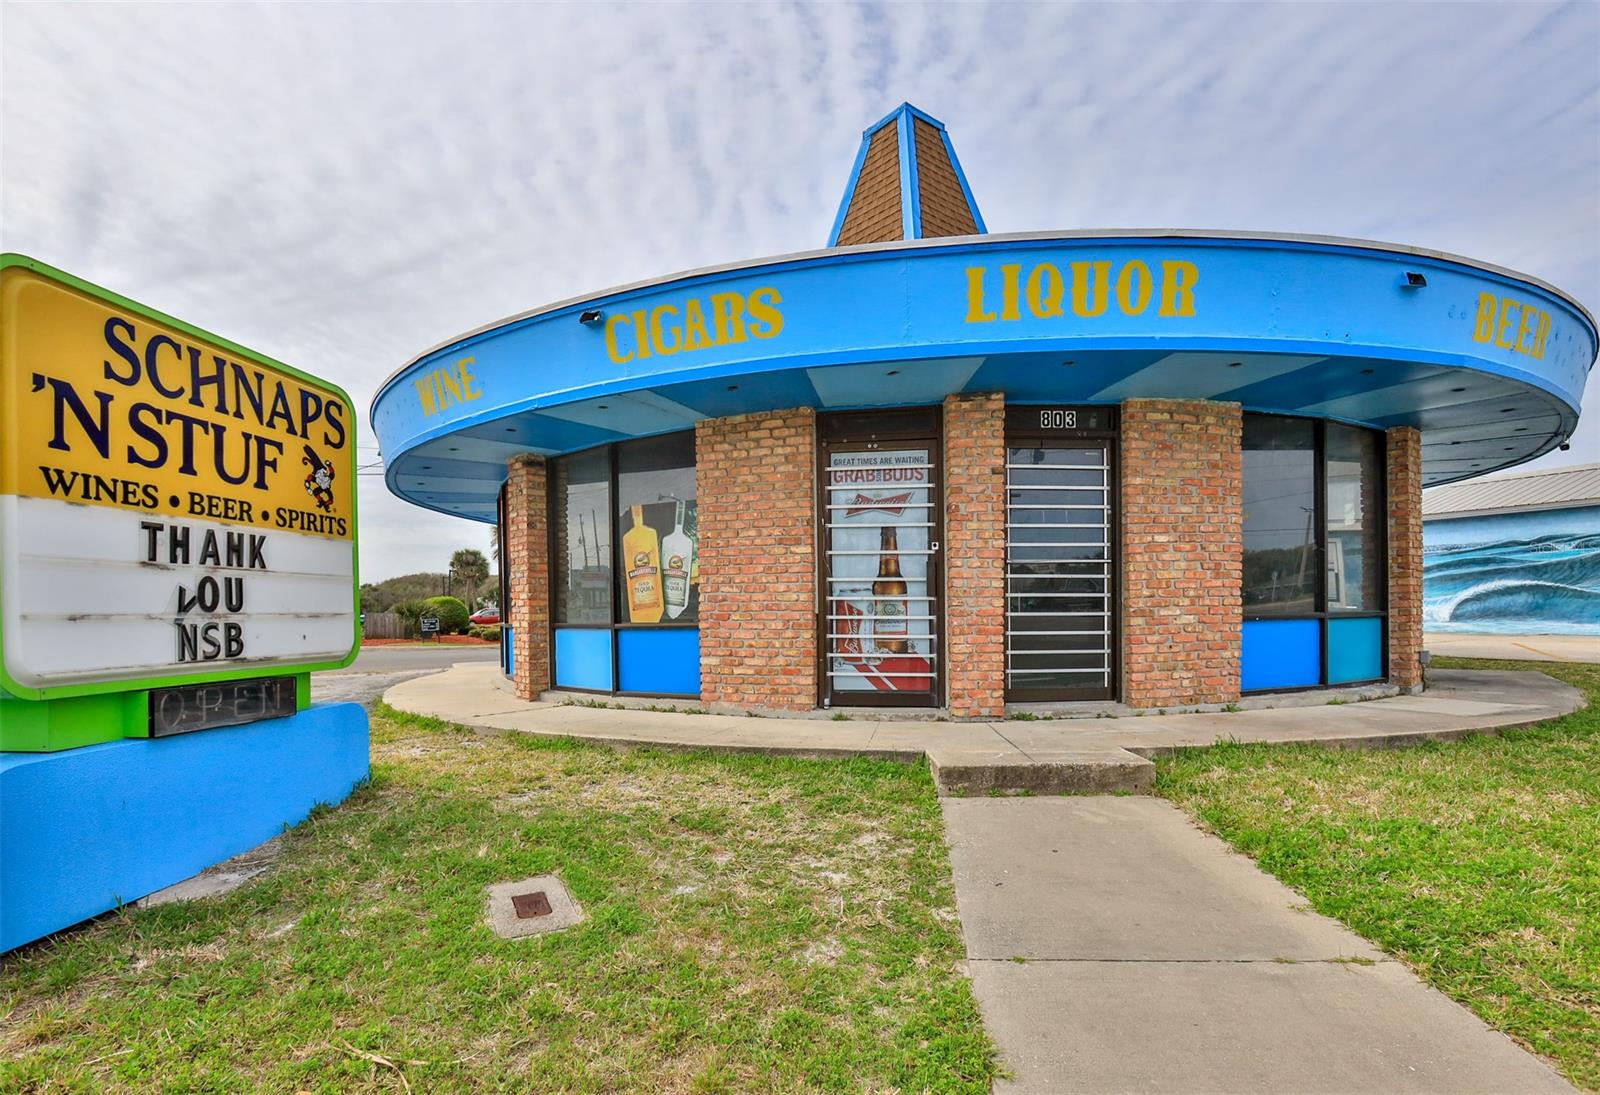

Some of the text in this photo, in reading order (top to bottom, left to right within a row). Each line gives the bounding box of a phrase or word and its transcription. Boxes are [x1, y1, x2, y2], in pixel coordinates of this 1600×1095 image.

[964, 259, 1199, 323] LIQUOR
[605, 287, 784, 364] CIGARS
[1472, 292, 1553, 360] BEER
[103, 316, 346, 449] SCHNAPS
[415, 356, 482, 416] WINE
[127, 402, 284, 490] STUF
[1041, 411, 1076, 428] 803
[833, 468, 876, 483] GRAB
[883, 467, 924, 482] BUDS
[834, 458, 855, 466] GREAT
[856, 457, 878, 465] TIMES
[894, 456, 924, 464] WAITING
[39, 465, 347, 537] WINES BEER SPIRITS
[141, 521, 267, 569] THANK
[178, 621, 244, 661] NSB
